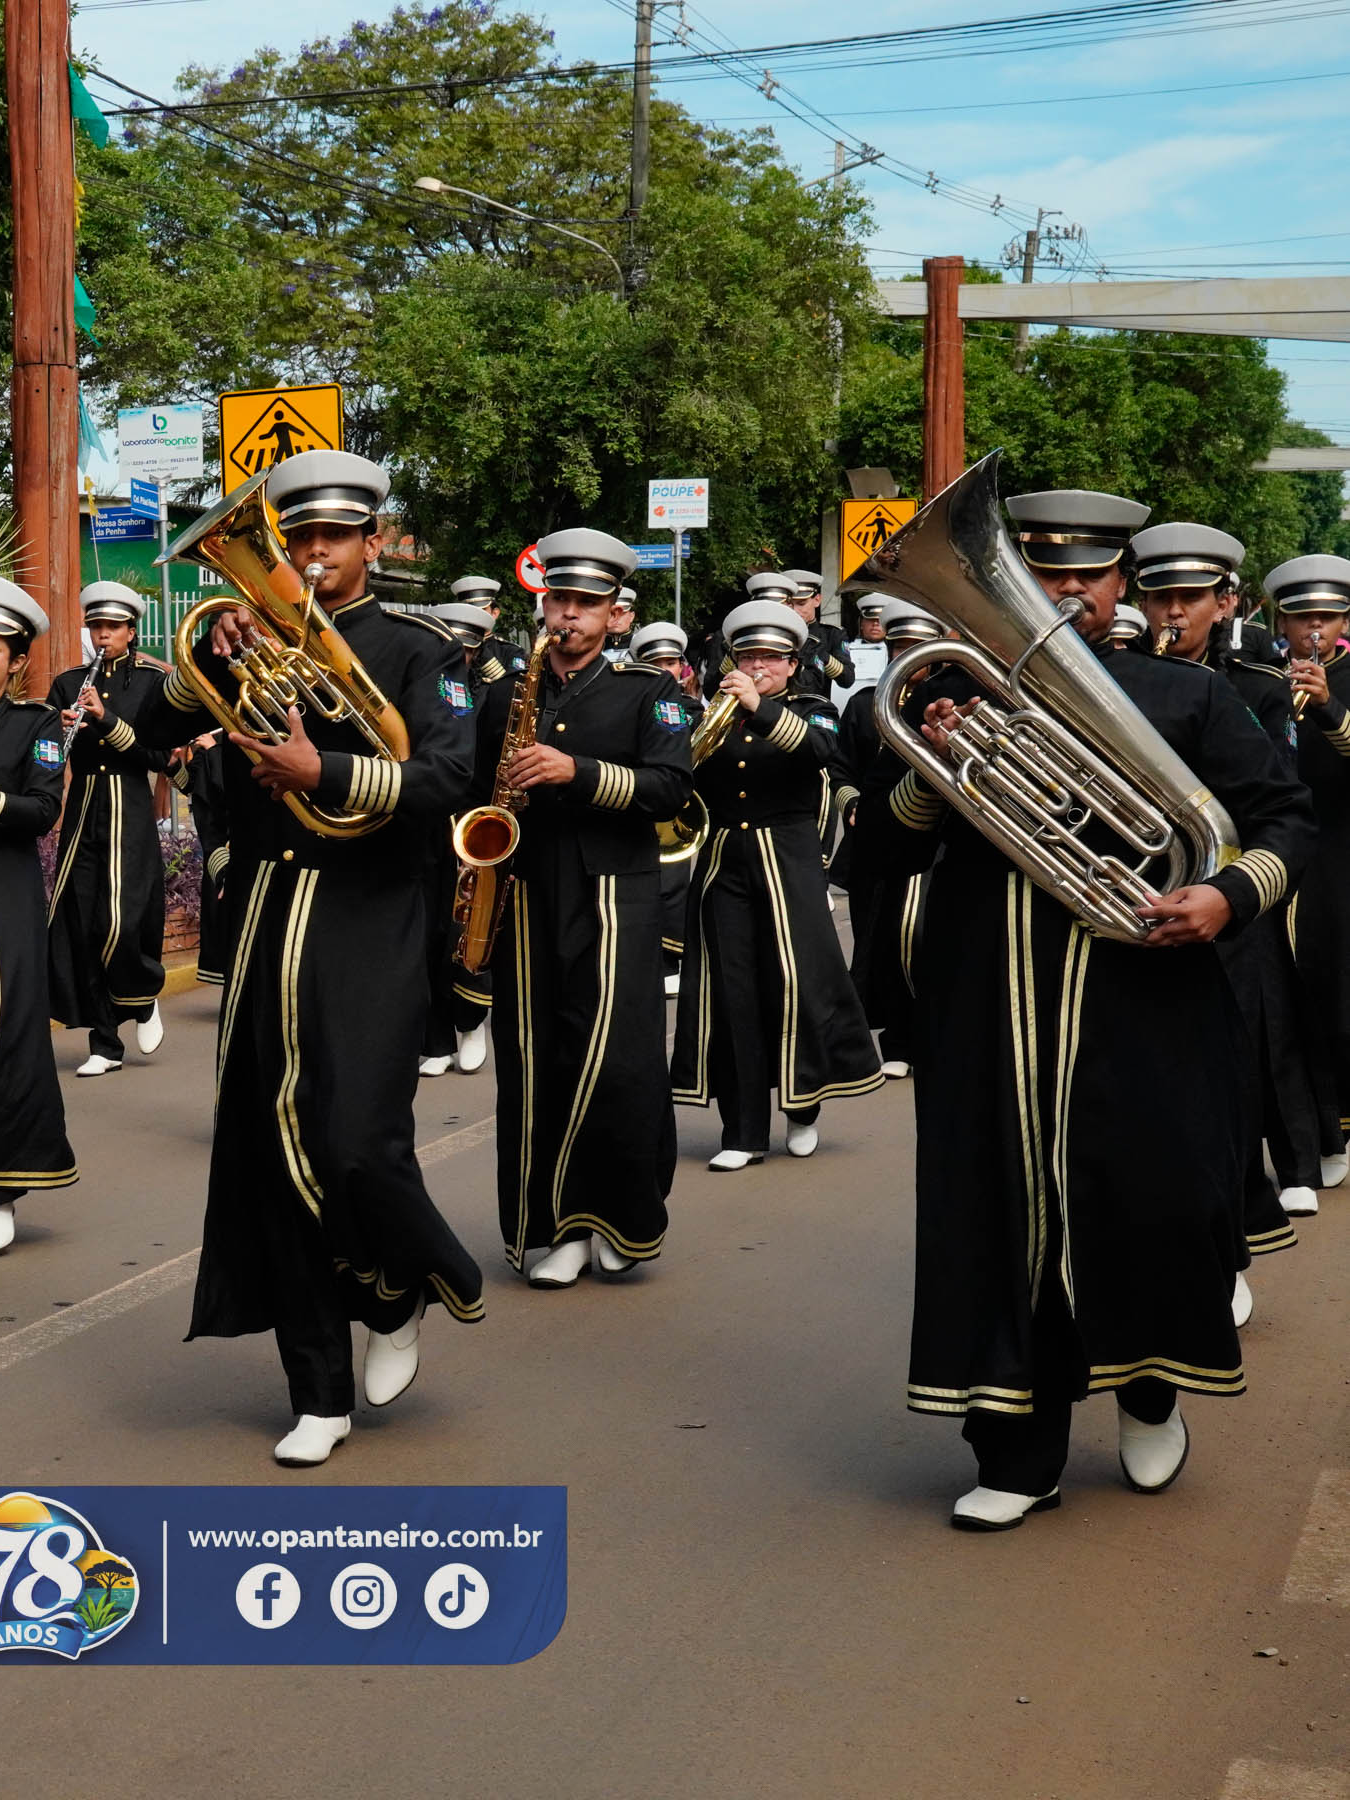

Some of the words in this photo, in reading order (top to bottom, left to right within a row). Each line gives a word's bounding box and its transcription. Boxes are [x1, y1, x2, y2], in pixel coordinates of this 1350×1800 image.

[96, 520, 116, 528] Nossa
[118, 518, 145, 526] Senhora
[96, 528, 104, 536] da
[105, 527, 126, 536] Penha
